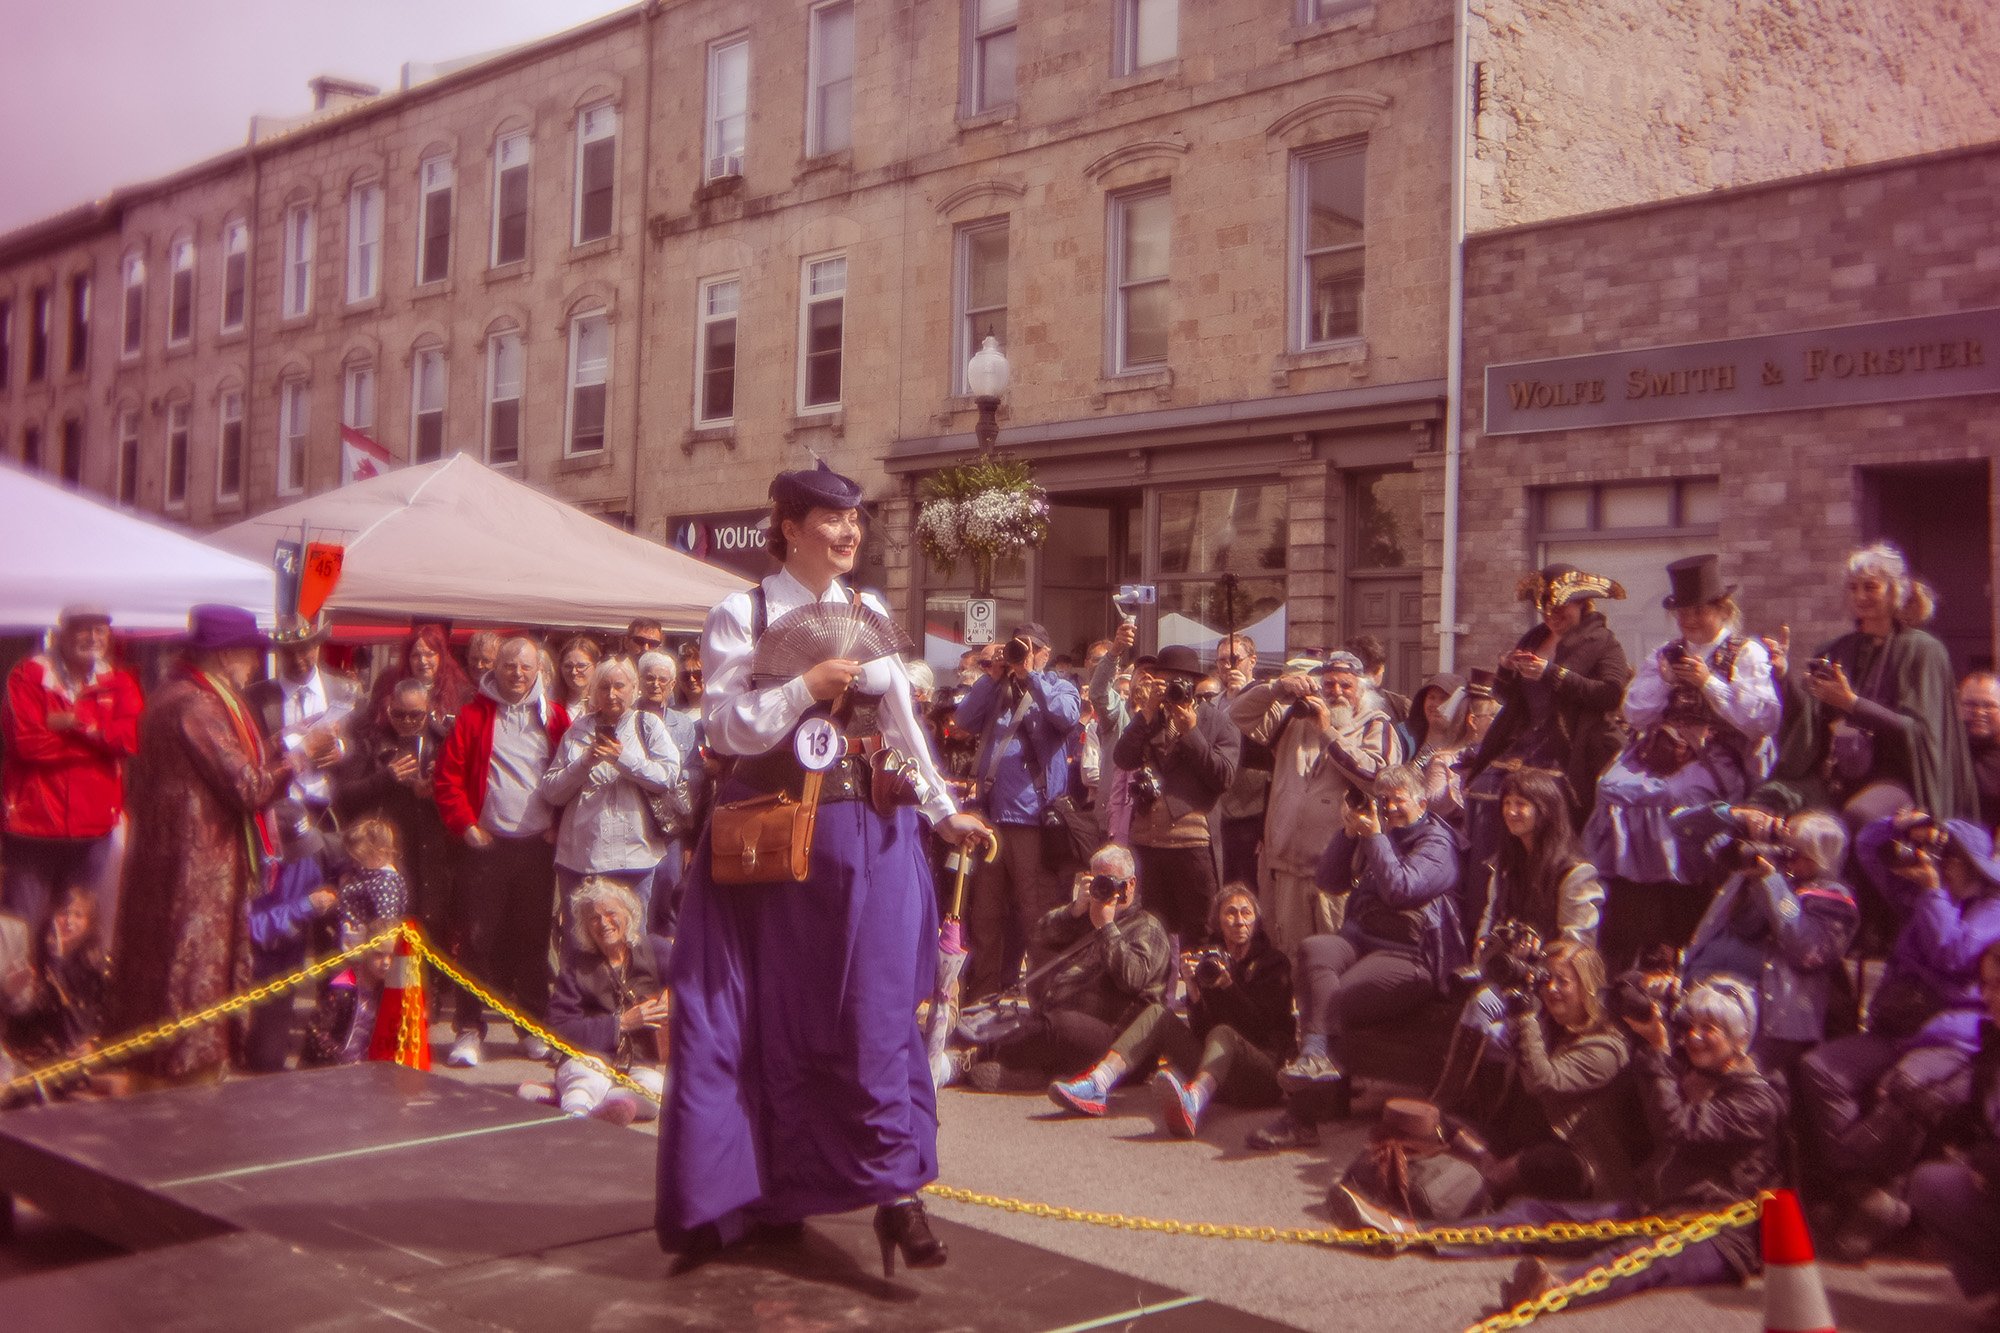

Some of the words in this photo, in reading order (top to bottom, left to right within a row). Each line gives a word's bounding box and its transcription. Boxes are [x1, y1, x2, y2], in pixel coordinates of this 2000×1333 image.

[1507, 379, 1605, 410] WOLFE
[1626, 365, 1737, 400] SMITH
[1761, 361, 1784, 386] &
[1803, 338, 1985, 381] FORSTER
[315, 559, 333, 577] 45
[976, 606, 986, 617] P
[978, 621, 987, 629] HR
[806, 732, 829, 757] 13
